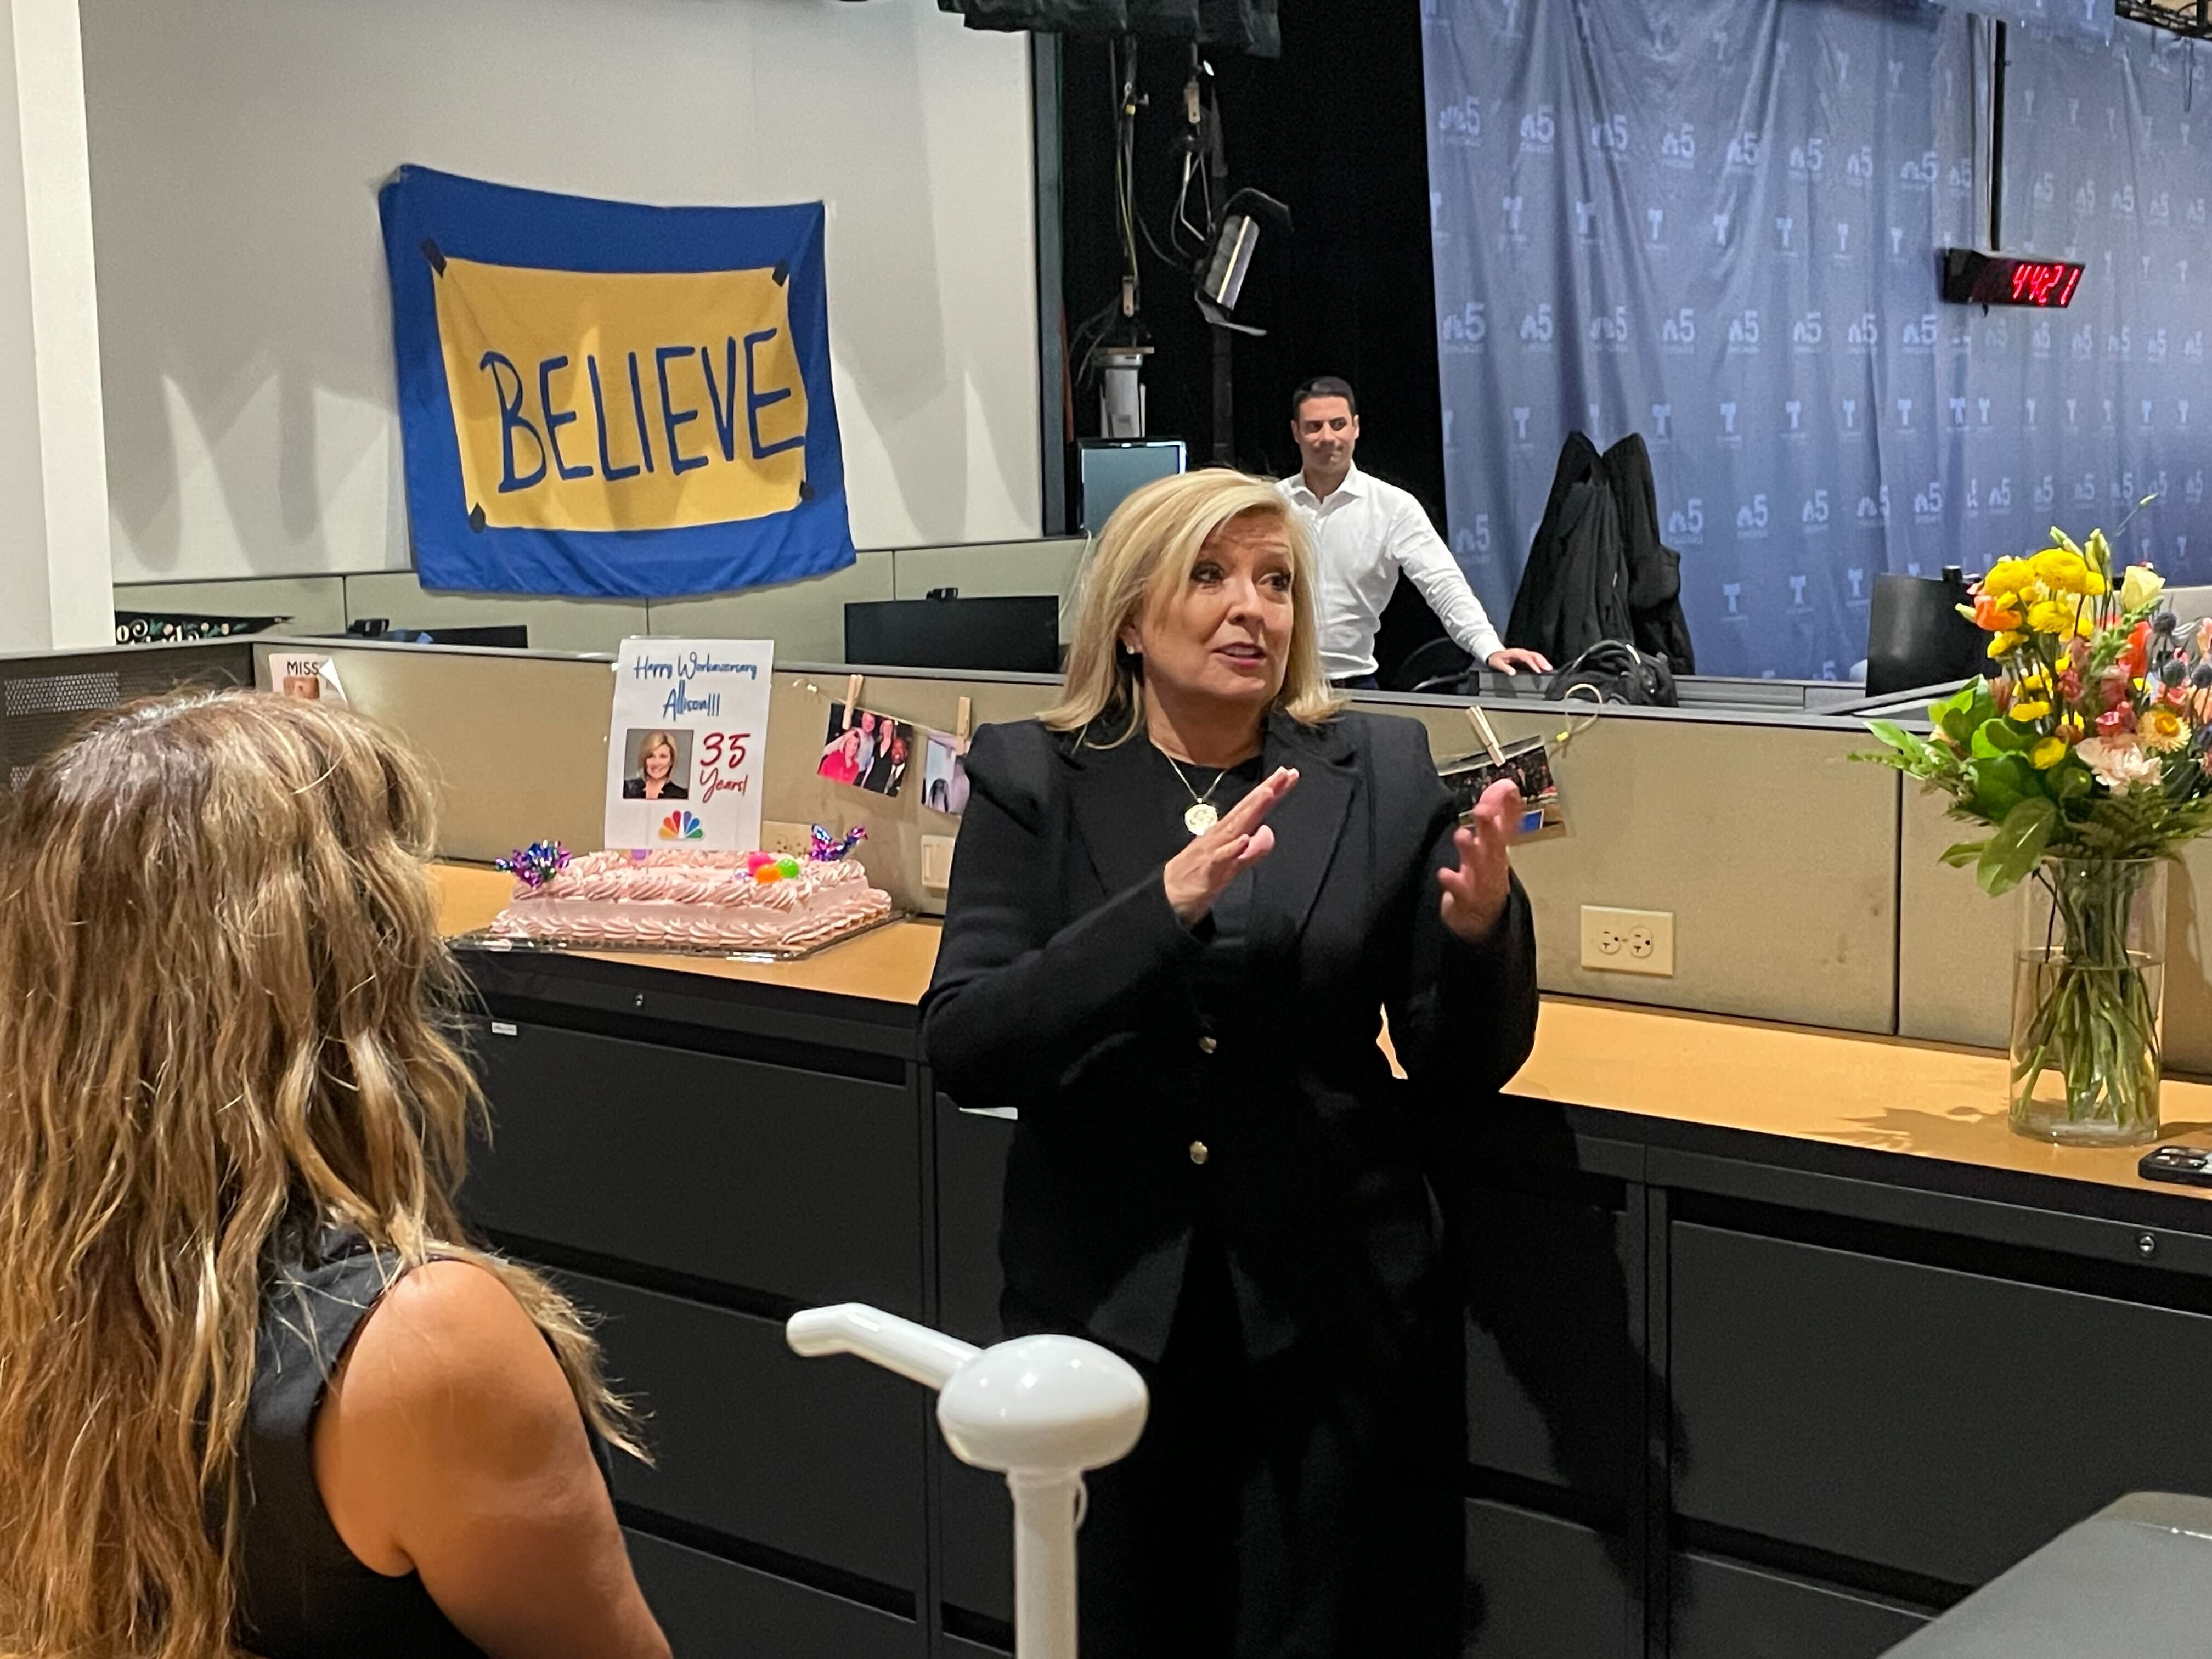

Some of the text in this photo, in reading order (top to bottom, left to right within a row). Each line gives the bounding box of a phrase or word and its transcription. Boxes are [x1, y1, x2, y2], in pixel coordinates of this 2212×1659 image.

[1465, 302, 1485, 341] 5
[1539, 303, 1553, 341] 5
[1616, 306, 1627, 341] 5
[1680, 308, 1694, 342] 5
[1744, 310, 1759, 342] 5
[1807, 312, 1821, 343] 5
[480, 327, 805, 493] BELIEVE
[1754, 494, 1768, 527] 5
[1815, 490, 1828, 521] 5
[1929, 482, 1942, 511] 5
[1476, 514, 1490, 551] 5
[1688, 498, 1702, 533] 5
[287, 661, 319, 676] MISS
[633, 656, 673, 680] Happy
[700, 732, 751, 768] 35
